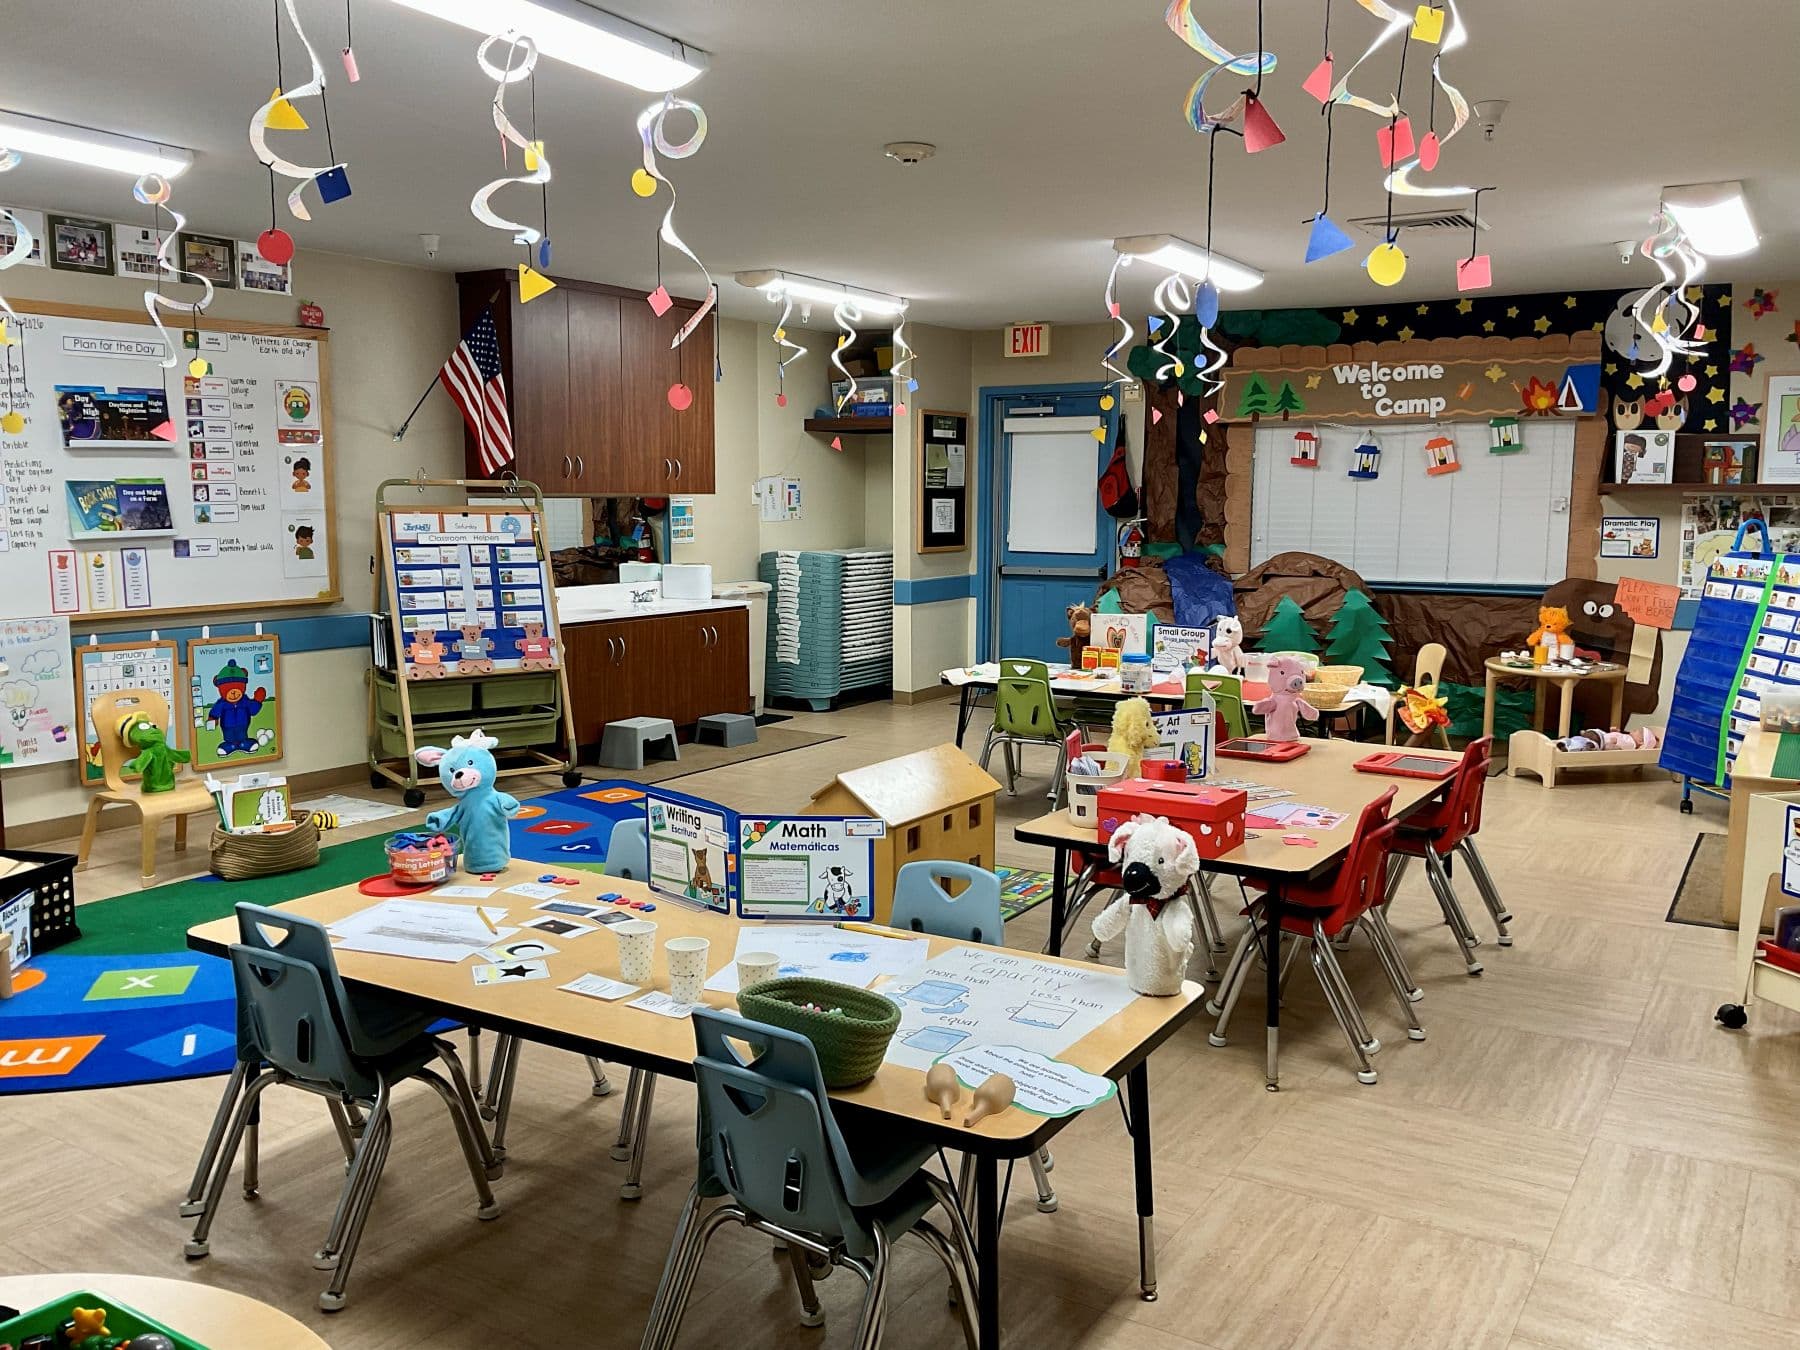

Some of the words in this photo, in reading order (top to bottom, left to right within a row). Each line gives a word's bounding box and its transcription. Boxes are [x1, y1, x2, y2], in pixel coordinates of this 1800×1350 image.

[74, 339, 97, 350] Plan
[100, 341, 113, 351] for
[116, 343, 133, 352] the
[136, 343, 155, 354] Day
[1013, 326, 1043, 353] EXIT
[1332, 361, 1445, 384] Welcome
[1360, 383, 1387, 400] to
[74, 395, 90, 403] Day
[83, 408, 100, 417] Nigh
[1375, 397, 1447, 418] Camp
[146, 489, 163, 497] Night
[1640, 520, 1656, 528] Play
[428, 534, 467, 542] Classroom
[1158, 627, 1179, 636] Small
[1181, 629, 1206, 638] Group
[112, 651, 147, 661] January
[238, 645, 269, 653] Weather?
[1166, 716, 1180, 726] Art
[666, 805, 702, 831] Writing
[671, 824, 697, 840] Escritura
[781, 823, 827, 838] Math
[769, 841, 840, 851] Matemáticas
[962, 949, 985, 960] We
[992, 955, 1019, 967] can
[1032, 963, 1091, 981] measure
[926, 968, 957, 979] more
[963, 974, 991, 986] than
[971, 962, 1072, 991] Capacity
[939, 1014, 979, 1027] equal
